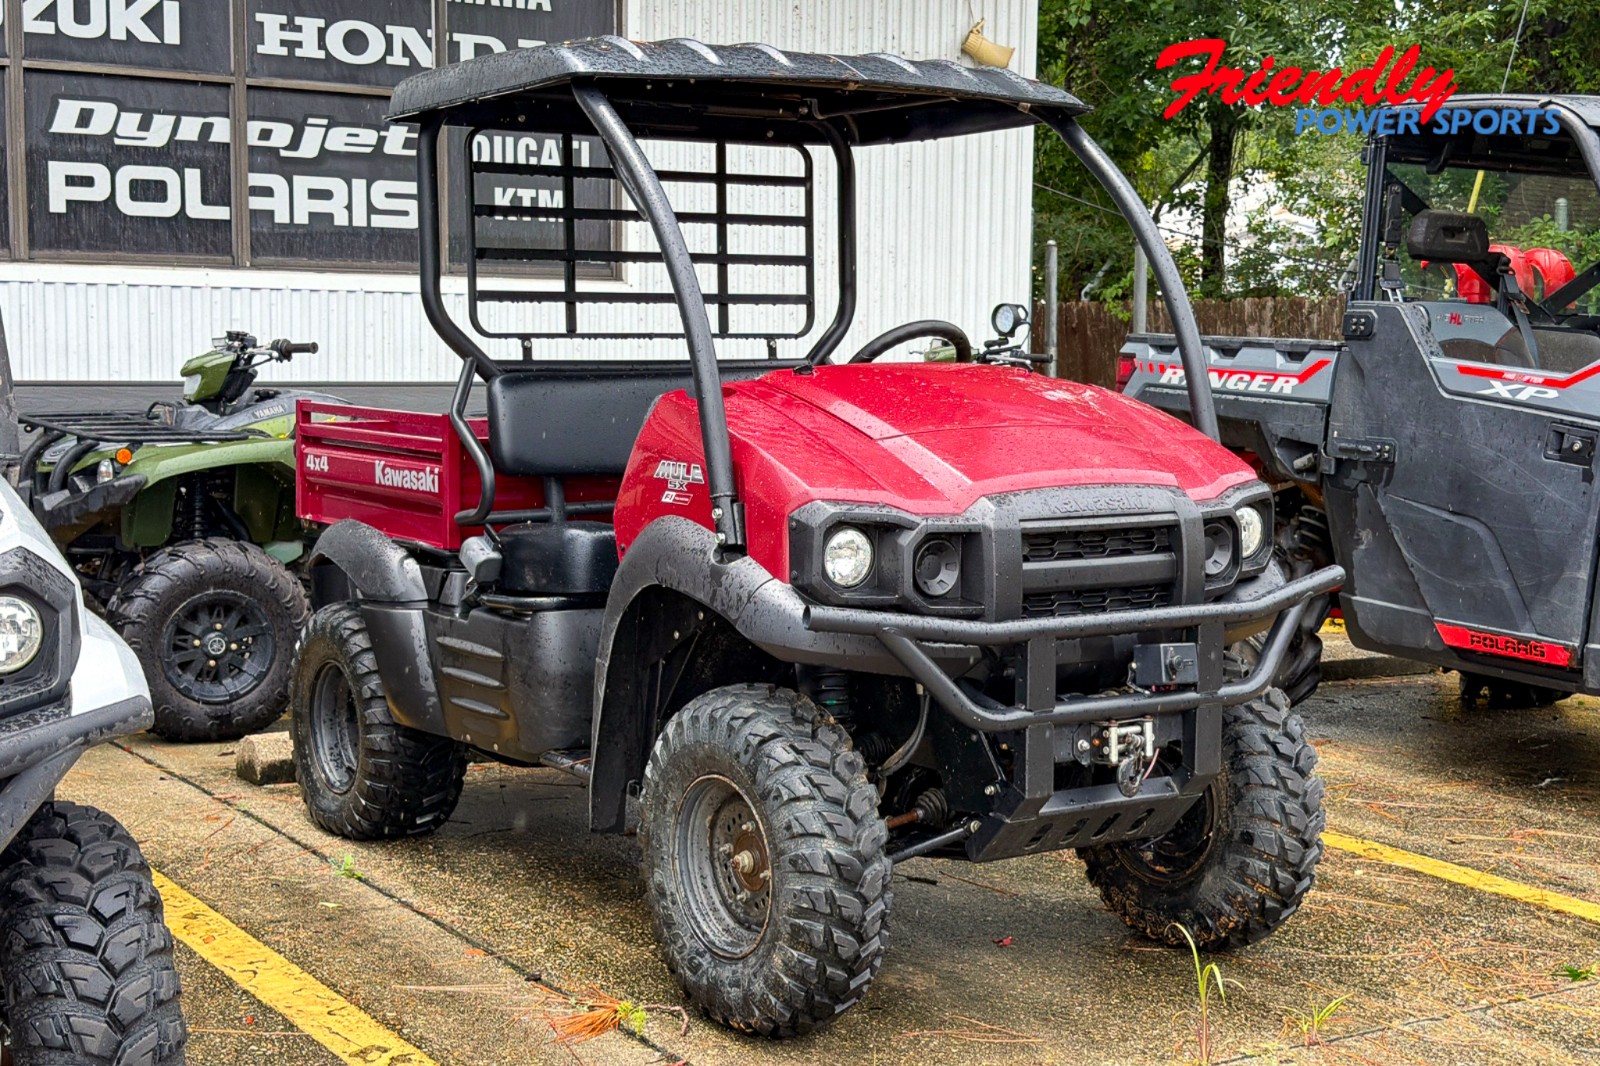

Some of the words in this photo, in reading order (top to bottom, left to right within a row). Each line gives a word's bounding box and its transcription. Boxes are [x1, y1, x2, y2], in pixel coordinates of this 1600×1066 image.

[0, 0, 181, 45] ZUKI
[256, 13, 547, 68] HOND
[49, 99, 419, 160] Dynojet
[48, 161, 419, 229] POLARIS
[494, 187, 564, 222] KTM
[1159, 367, 1299, 394] RNGER
[1476, 380, 1559, 400] XP
[253, 404, 286, 418] YAMAHA
[306, 454, 329, 472] 4x4
[375, 460, 439, 493] Kawasaki
[653, 460, 705, 484] MULE
[668, 480, 687, 491] SX
[1470, 634, 1546, 658] POLARIS
